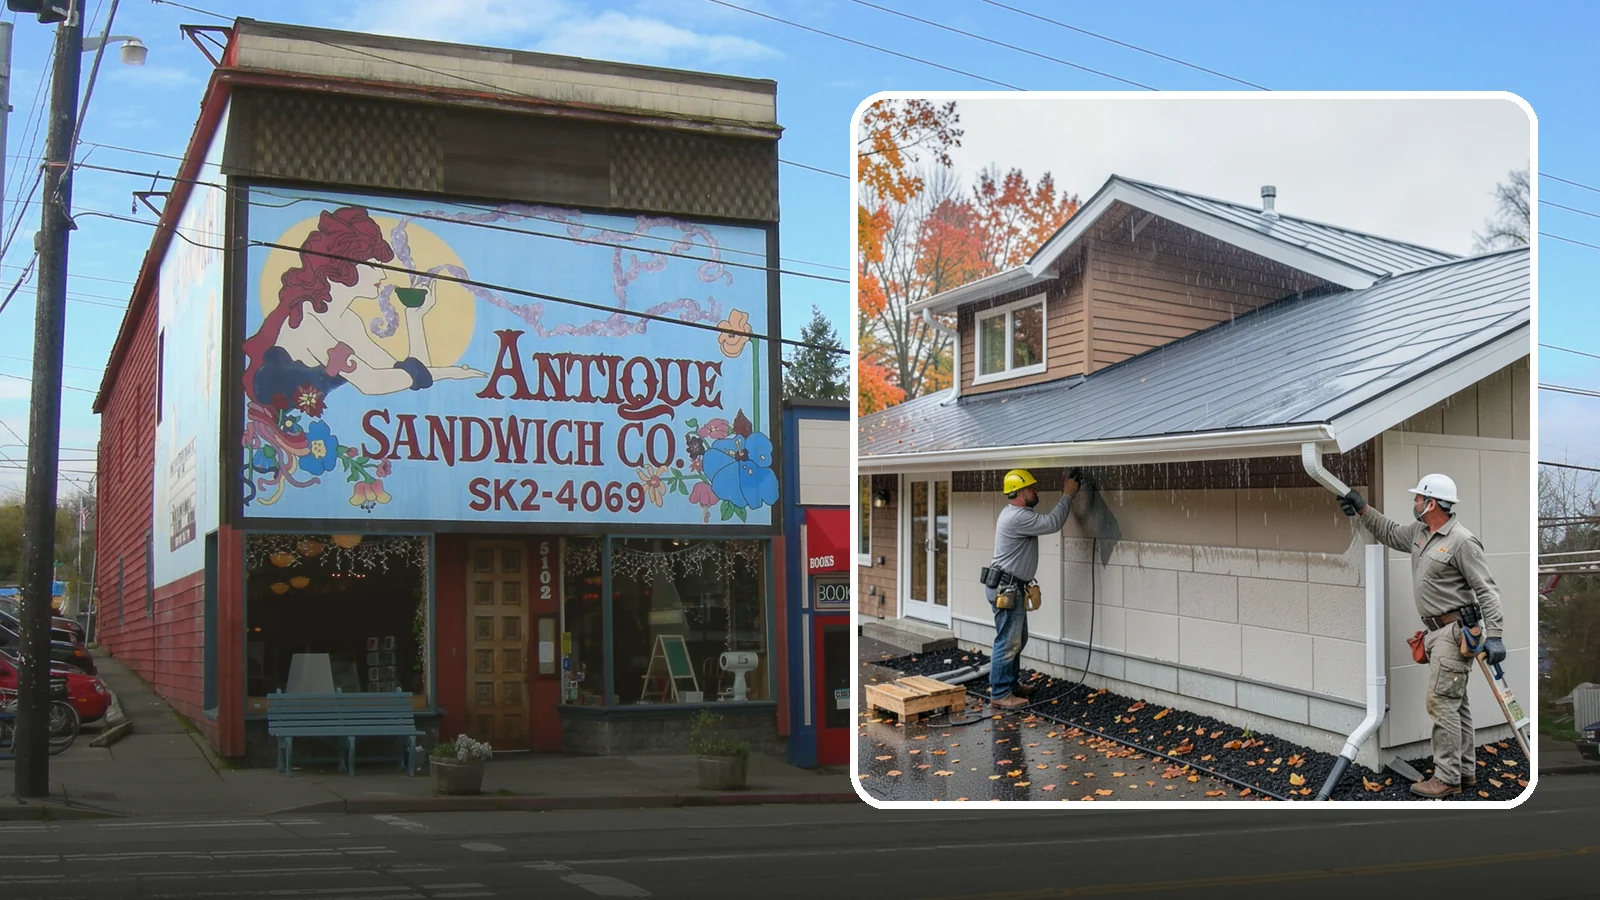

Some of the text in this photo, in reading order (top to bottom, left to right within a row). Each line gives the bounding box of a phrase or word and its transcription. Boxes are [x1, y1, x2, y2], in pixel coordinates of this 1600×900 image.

[476, 329, 723, 420] ANTIQUE
[361, 409, 685, 469] SANDWICH CO.
[468, 477, 645, 512] SK2-4069
[540, 541, 551, 600] 5102
[809, 555, 835, 569] BOOKS
